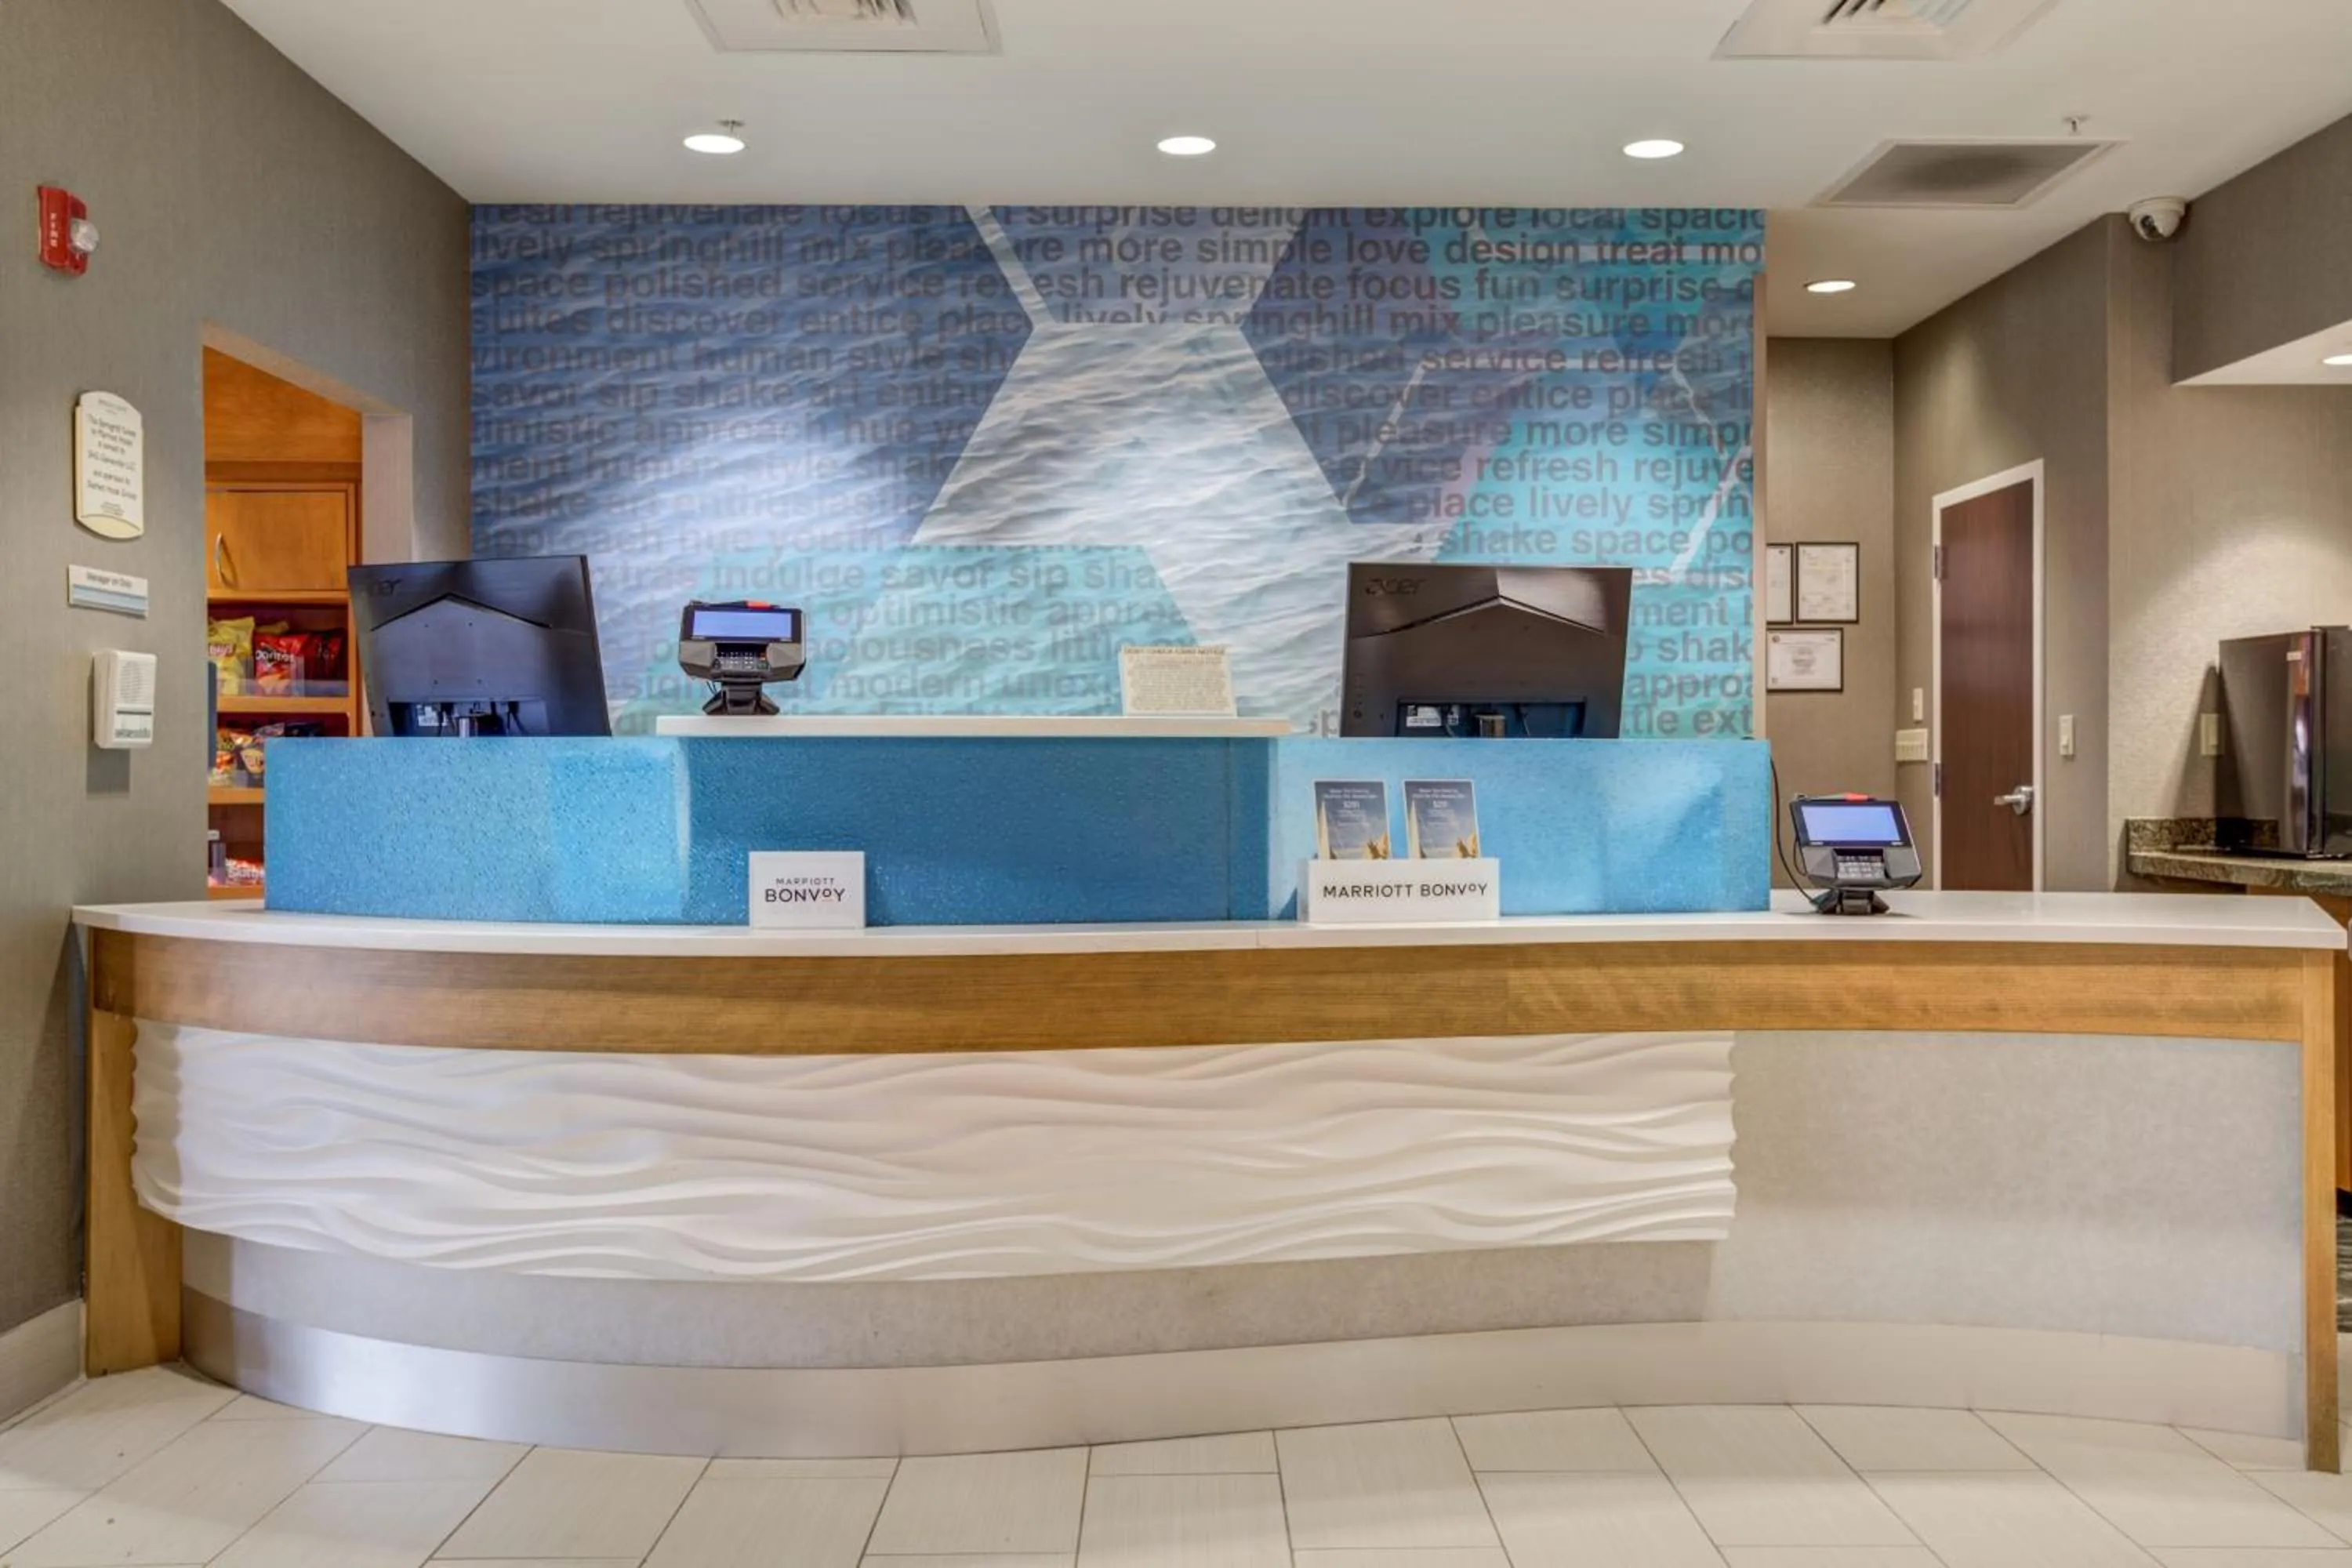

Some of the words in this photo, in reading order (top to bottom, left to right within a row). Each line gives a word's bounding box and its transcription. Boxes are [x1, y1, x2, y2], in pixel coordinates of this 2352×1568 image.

[1027, 205, 1196, 235] surprise
[1365, 207, 1516, 235] explore
[1531, 208, 1625, 229] local
[592, 229, 782, 271] springhill
[800, 230, 869, 262] mix
[1079, 236, 1182, 263] more
[1197, 230, 1332, 274] simple
[1345, 230, 1431, 263] love
[1445, 231, 1581, 274] design
[1596, 234, 1686, 265] treat
[604, 265, 782, 306] polished
[797, 266, 945, 299] service
[959, 265, 1104, 299] reesh
[1120, 266, 1335, 309] rejuvenate
[1347, 267, 1461, 300] focus
[1475, 267, 1540, 300] fun
[1556, 269, 1720, 311] surprise
[605, 303, 780, 336] discover
[800, 301, 923, 336] entice
[1477, 306, 1650, 343] pleasure
[694, 337, 832, 372] human
[1421, 339, 1566, 373] service
[1471, 376, 1593, 410] entice
[844, 412, 917, 444] hue
[1338, 415, 1512, 453] pleasure
[1526, 421, 1629, 447] more
[1476, 449, 1618, 482] refresh
[1530, 486, 1633, 524] lively
[1439, 521, 1557, 554] shake
[1572, 528, 1690, 563] space
[880, 561, 995, 590] savor
[1007, 557, 1070, 599] sip
[1084, 556, 1166, 590] sha
[1626, 672, 1753, 710] appro
[764, 887, 846, 902] BONVOY
[775, 877, 835, 886] MARRIOTT
[1323, 884, 1413, 898] MARRIOTT
[1420, 883, 1488, 898] BONVOY
